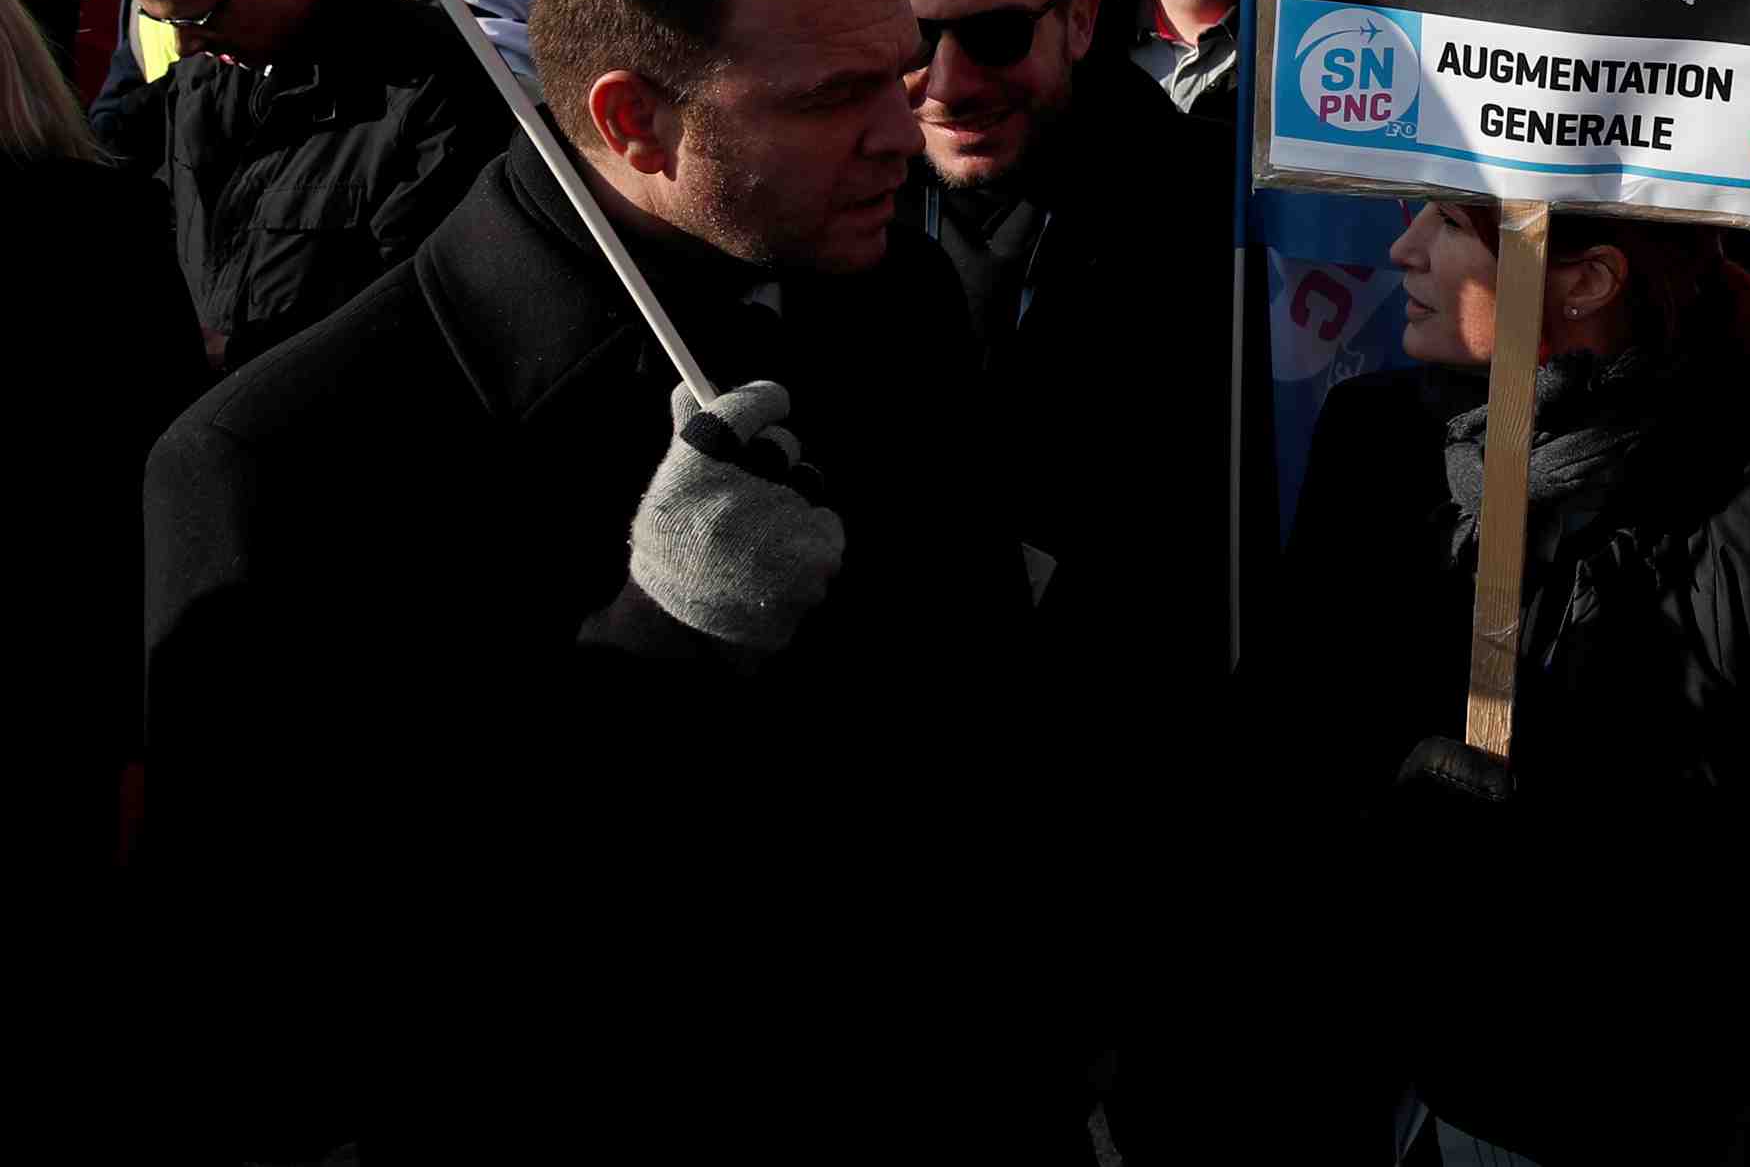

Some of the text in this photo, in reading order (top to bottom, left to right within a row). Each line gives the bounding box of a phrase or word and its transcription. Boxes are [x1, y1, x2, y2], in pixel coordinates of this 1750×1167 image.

[1321, 47, 1394, 91] SN
[1436, 41, 1734, 102] AUGMENTATION
[1319, 92, 1393, 123] PNC
[1480, 103, 1674, 151] GENERALE
